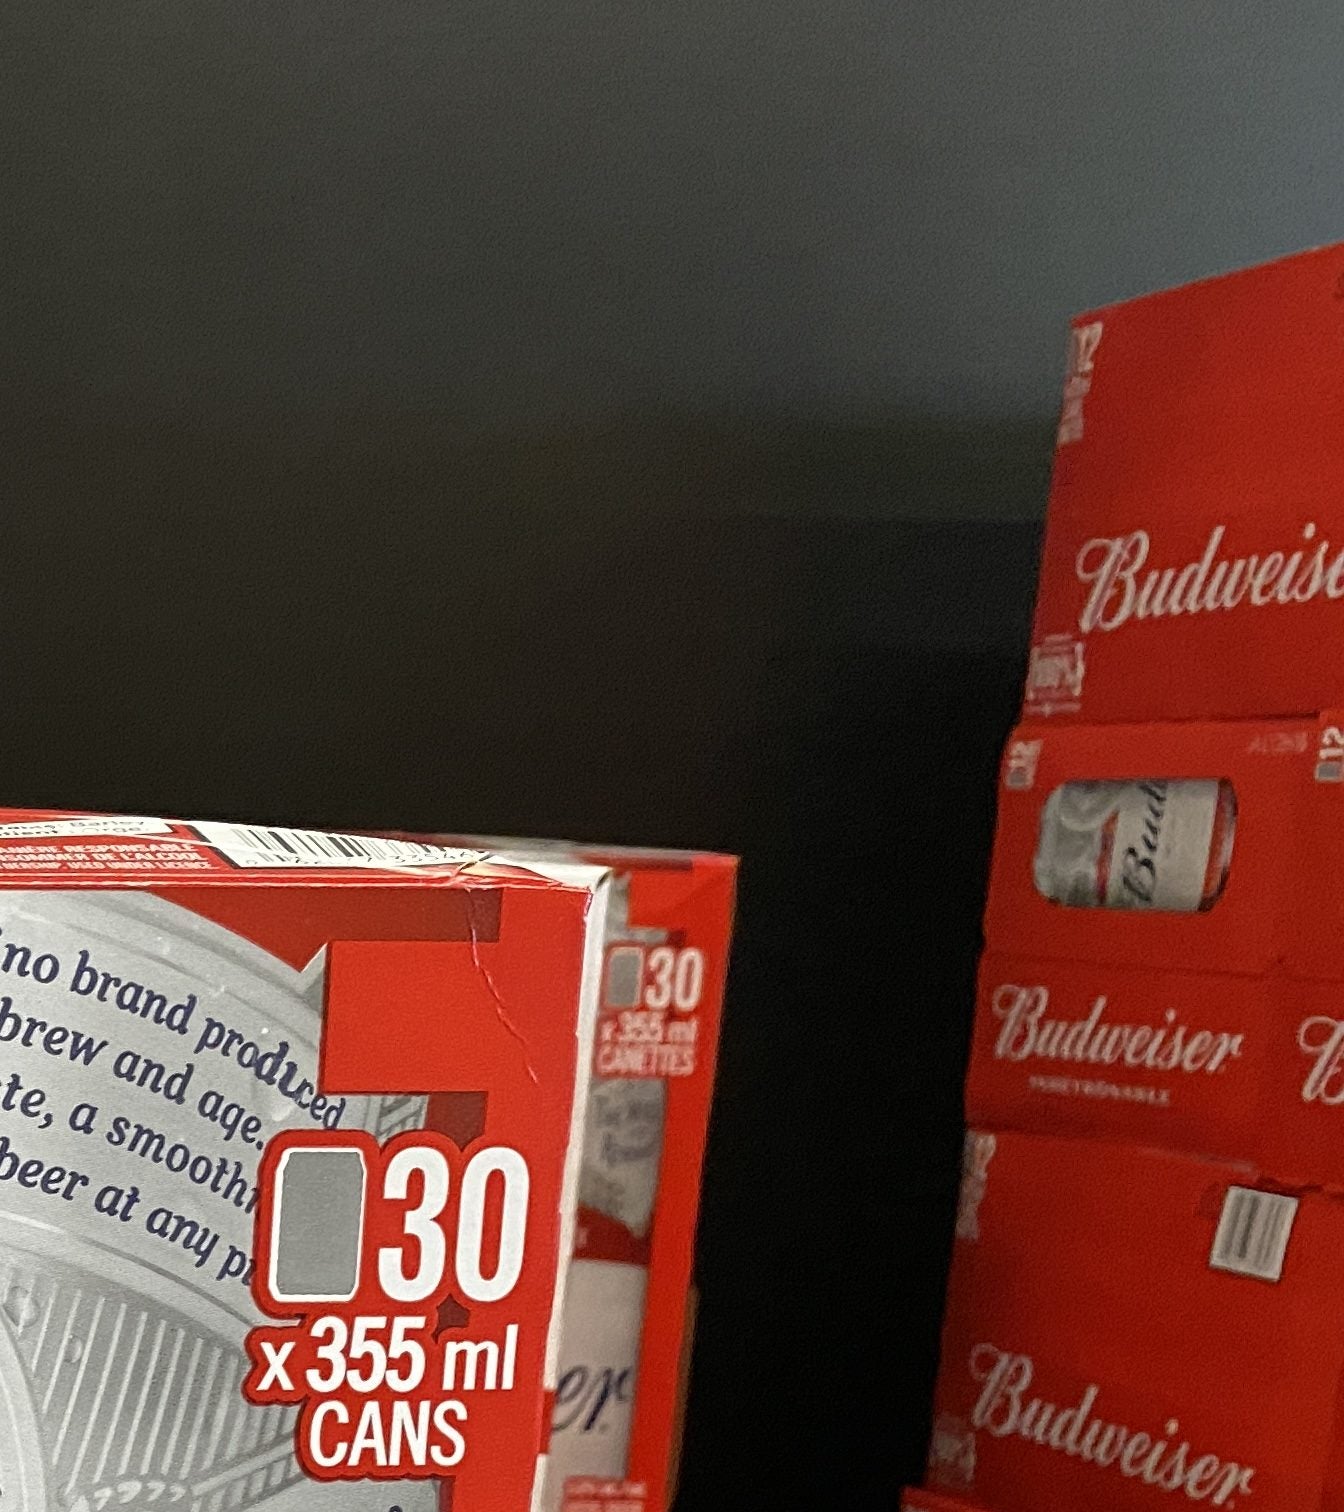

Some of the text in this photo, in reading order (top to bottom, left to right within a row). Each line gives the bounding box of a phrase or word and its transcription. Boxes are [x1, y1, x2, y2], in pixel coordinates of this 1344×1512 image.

[1075, 522, 1344, 634] Budweis
[646, 948, 704, 1010] 30
[1, 942, 59, 986] no
[69, 949, 197, 1035] brand
[194, 1011, 347, 1130] produced
[993, 986, 1243, 1073] Budweiser
[66, 1100, 99, 1134] a
[112, 1044, 194, 1106] and
[197, 1089, 265, 1151] age.
[93, 1181, 142, 1223] at
[145, 1204, 221, 1268] any
[378, 1146, 529, 1302] 30
[257, 1316, 518, 1392] x 355 ml
[310, 1401, 468, 1468] CANS
[970, 1343, 1255, 1508] Budweiser
